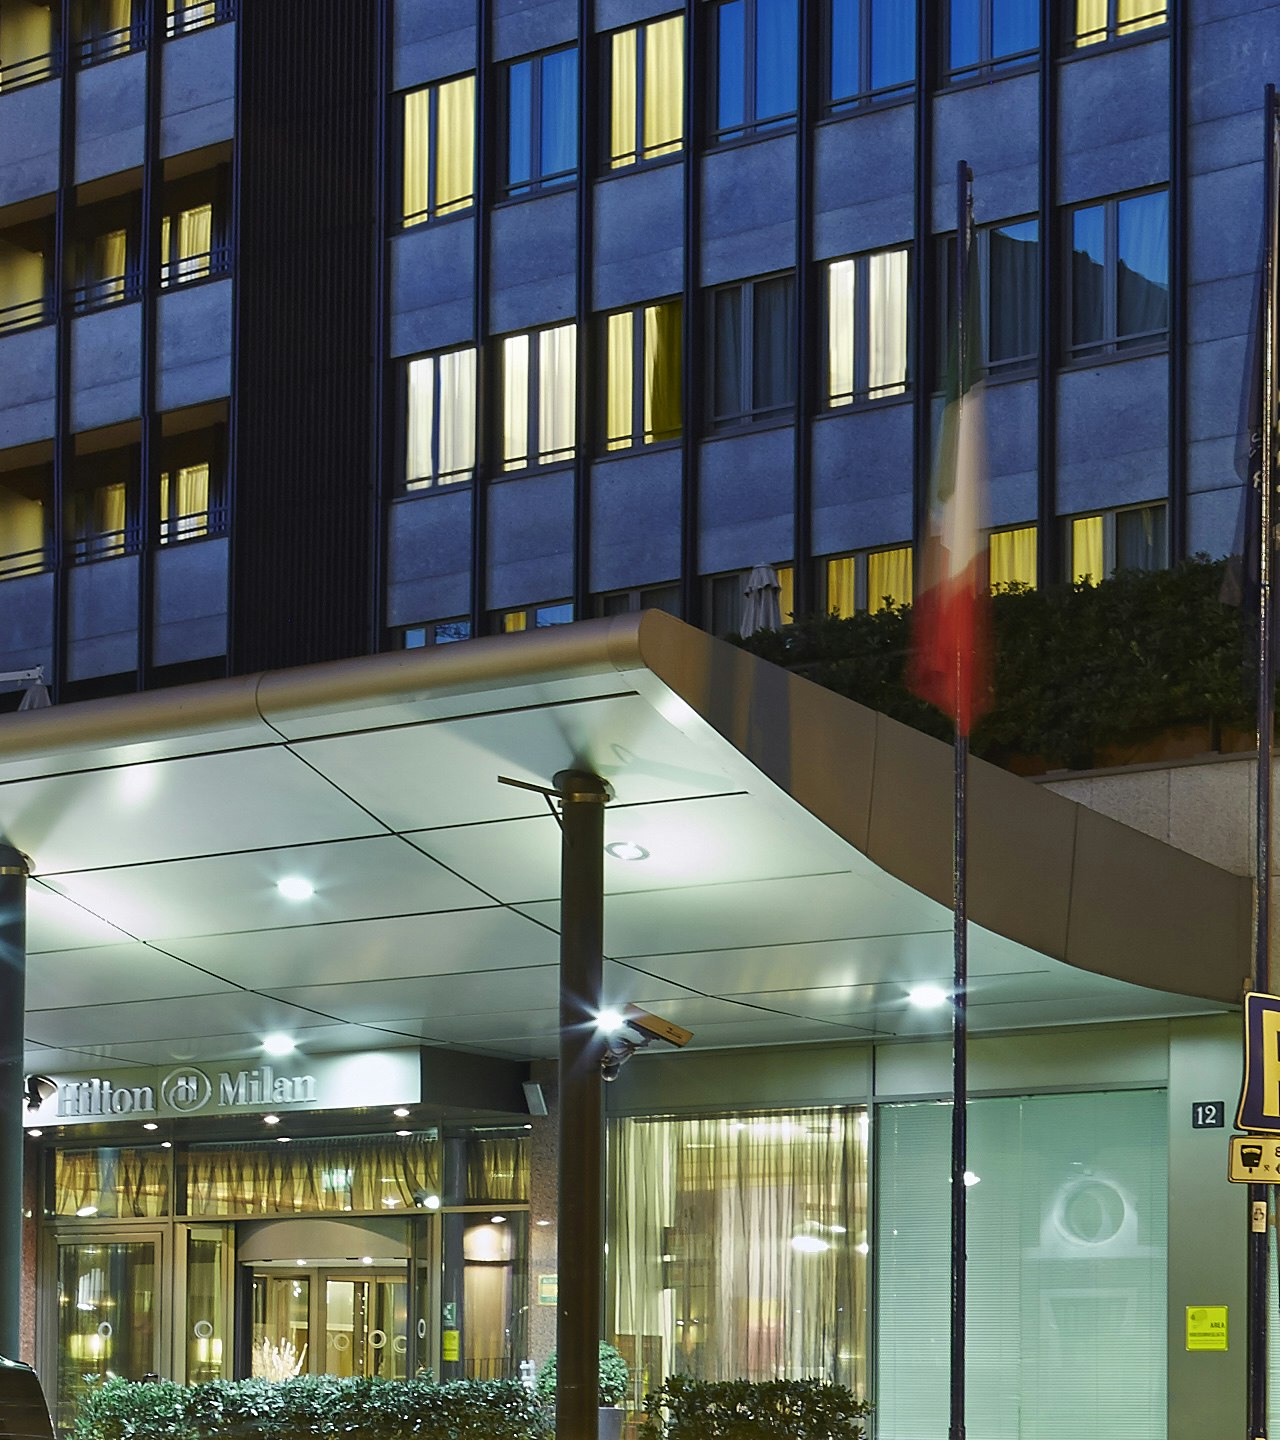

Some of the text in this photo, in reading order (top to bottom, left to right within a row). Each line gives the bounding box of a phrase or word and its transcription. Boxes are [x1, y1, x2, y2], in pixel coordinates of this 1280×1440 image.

[55, 1078, 154, 1118] Hilton
[218, 1066, 317, 1107] Milan
[1196, 1105, 1216, 1125] 12
